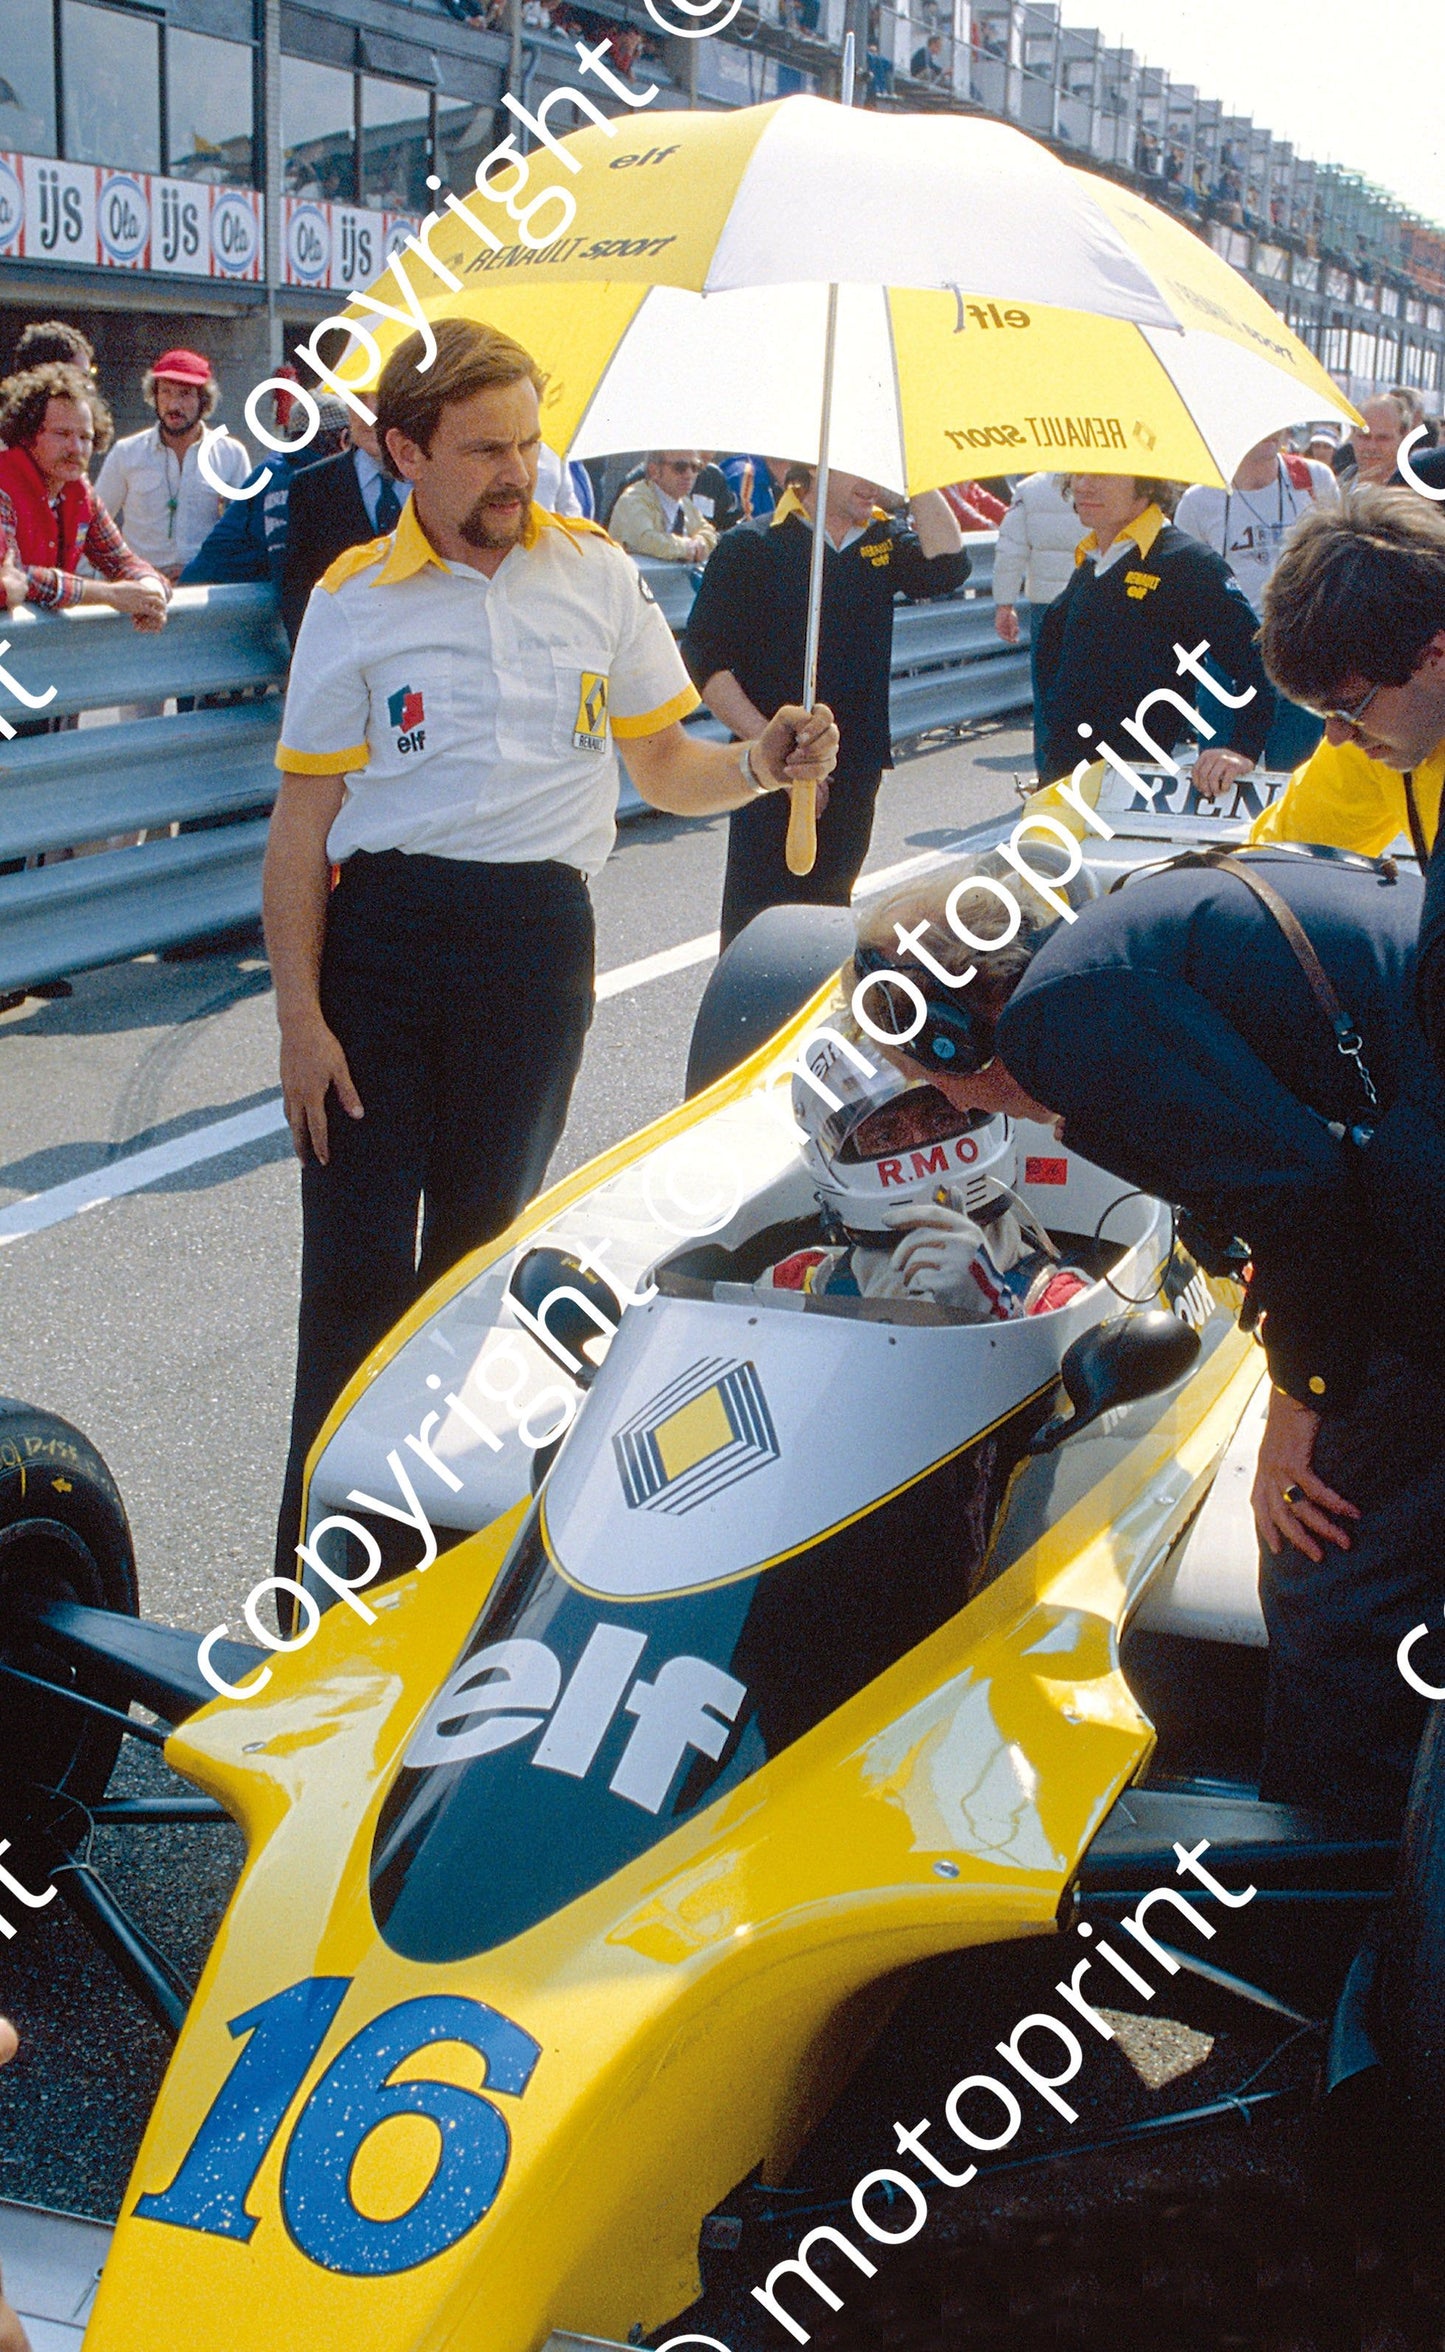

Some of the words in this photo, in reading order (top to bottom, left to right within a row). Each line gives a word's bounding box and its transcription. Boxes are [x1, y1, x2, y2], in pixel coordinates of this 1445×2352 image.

[609, 144, 681, 170] elf
[38, 169, 82, 250] ijs
[109, 193, 140, 241] Ola
[161, 188, 199, 263] ijs
[220, 209, 248, 253] Ola
[341, 214, 371, 282] ijs
[463, 237, 588, 274] RENAULT
[578, 236, 677, 259] sport
[397, 730, 426, 754] elf
[1124, 772, 1282, 820] REN
[402, 1622, 748, 1815] elf
[131, 1976, 543, 2279] 16
